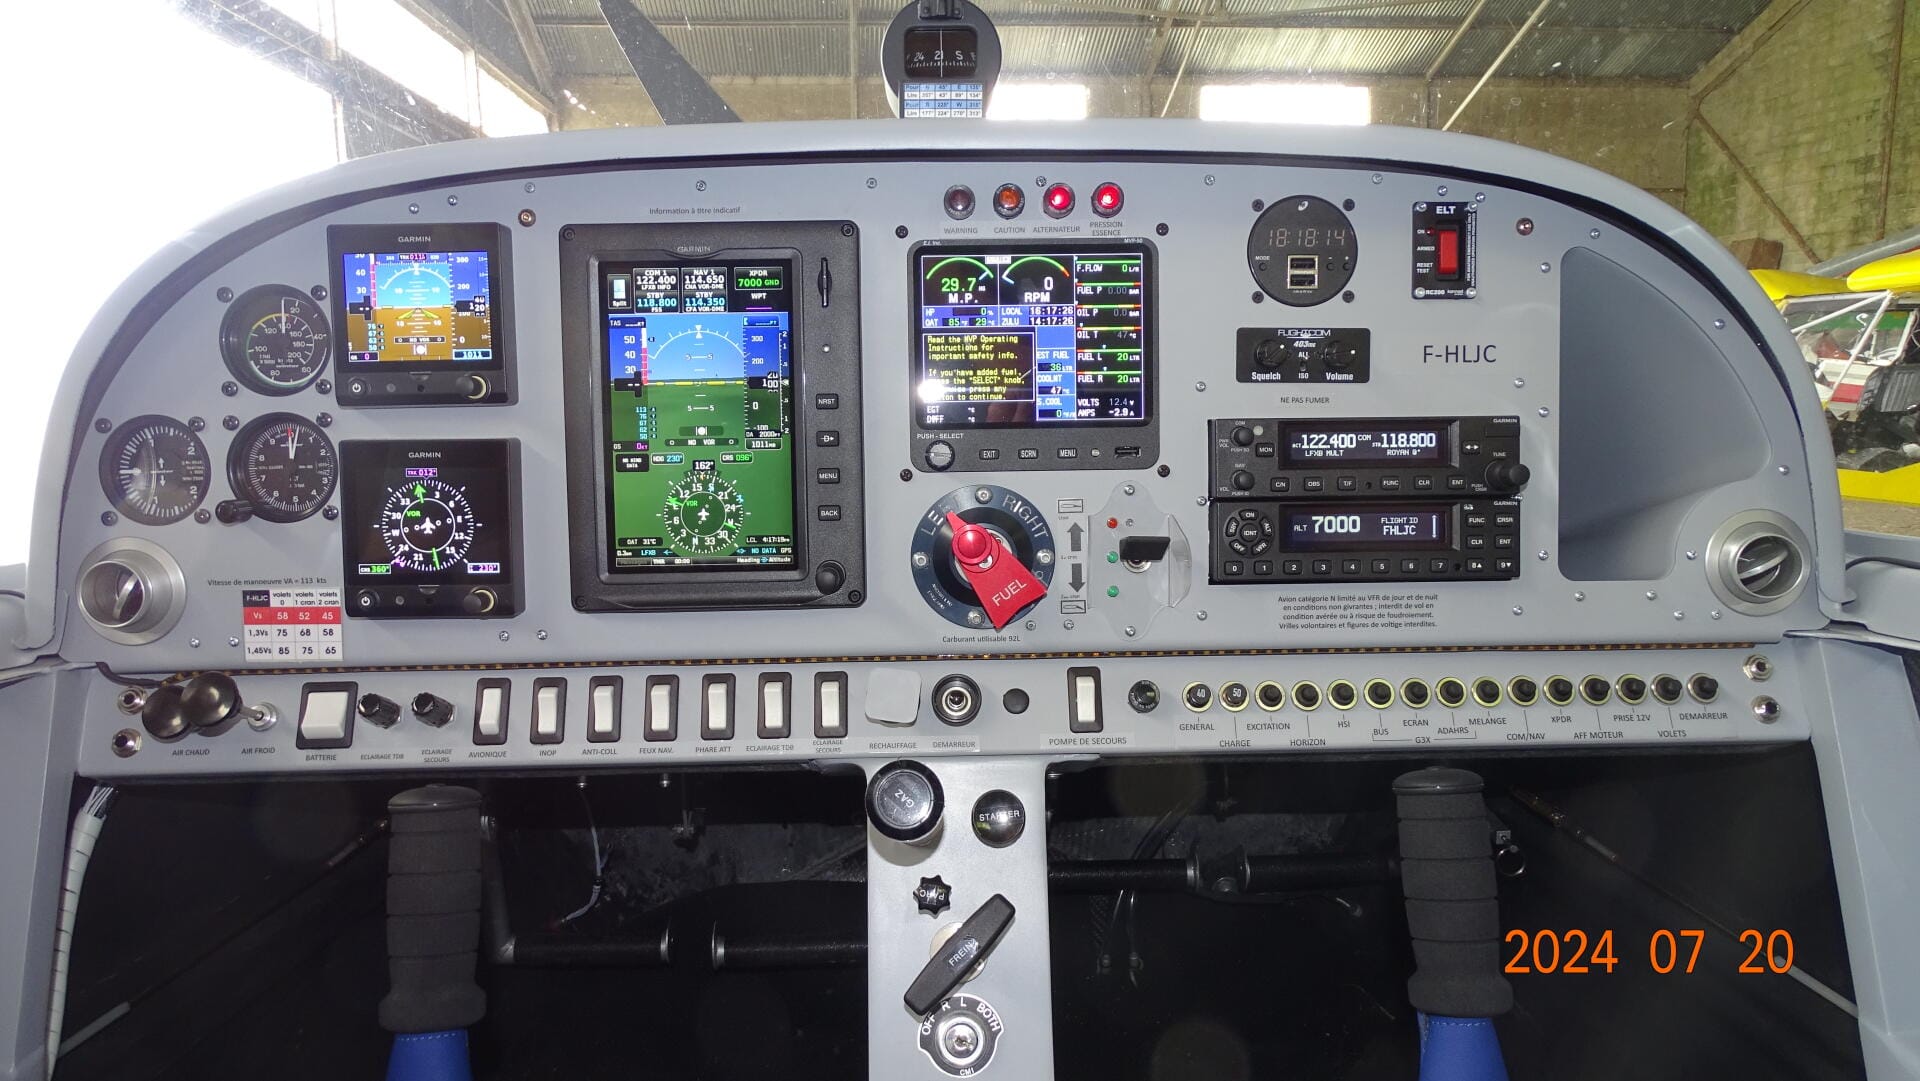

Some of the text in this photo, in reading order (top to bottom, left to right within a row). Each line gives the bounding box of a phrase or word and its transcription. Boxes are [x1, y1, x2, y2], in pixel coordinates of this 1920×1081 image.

[1436, 206, 1456, 214] ELT
[637, 276, 676, 284] 122.400
[685, 276, 724, 284] 114.650
[738, 279, 762, 287] 7000
[1044, 277, 1054, 290] 0
[941, 278, 977, 292] 29.7
[685, 298, 725, 306] 114.350
[948, 294, 978, 303] M.P.
[1024, 293, 1050, 303] RPM
[637, 299, 676, 307] 118.800
[1002, 307, 1073, 315] LOCAL 16:17:26
[1001, 317, 1073, 326] ZULU 14:17:26
[1423, 345, 1497, 363] F-HLJC
[1251, 372, 1281, 381] Squelch
[1326, 372, 1353, 380] Volume
[1037, 398, 1062, 406] S.COOL
[1078, 398, 1128, 406] VOLTS 12.4
[1078, 408, 1129, 416] AMPS -2.9
[1301, 434, 1356, 449] 122.400
[1381, 433, 1436, 448] 118.800
[188, 447, 195, 455] 2
[190, 486, 197, 494] 2
[1003, 494, 1049, 538] RIGHT
[1312, 516, 1360, 533] 7000
[1383, 526, 1416, 535] FHLJC
[992, 579, 1028, 607] FUEL
[1197, 688, 1205, 698] 40
[1232, 688, 1241, 697] 50
[1679, 712, 1728, 720] DEMARREUR
[1506, 733, 1545, 741] COM/NAV
[1589, 731, 1623, 739] MOTEUR
[1658, 730, 1687, 738] VOLETS
[1290, 738, 1326, 746] HORIZON
[894, 789, 914, 808] GAZ
[920, 889, 945, 900] PARC
[948, 941, 976, 967] FREIN
[941, 1001, 950, 1011] R
[960, 996, 967, 1007] L
[976, 1003, 1000, 1031] BOTH
[922, 1012, 936, 1035] OFF
[960, 1067, 974, 1076] CMI
